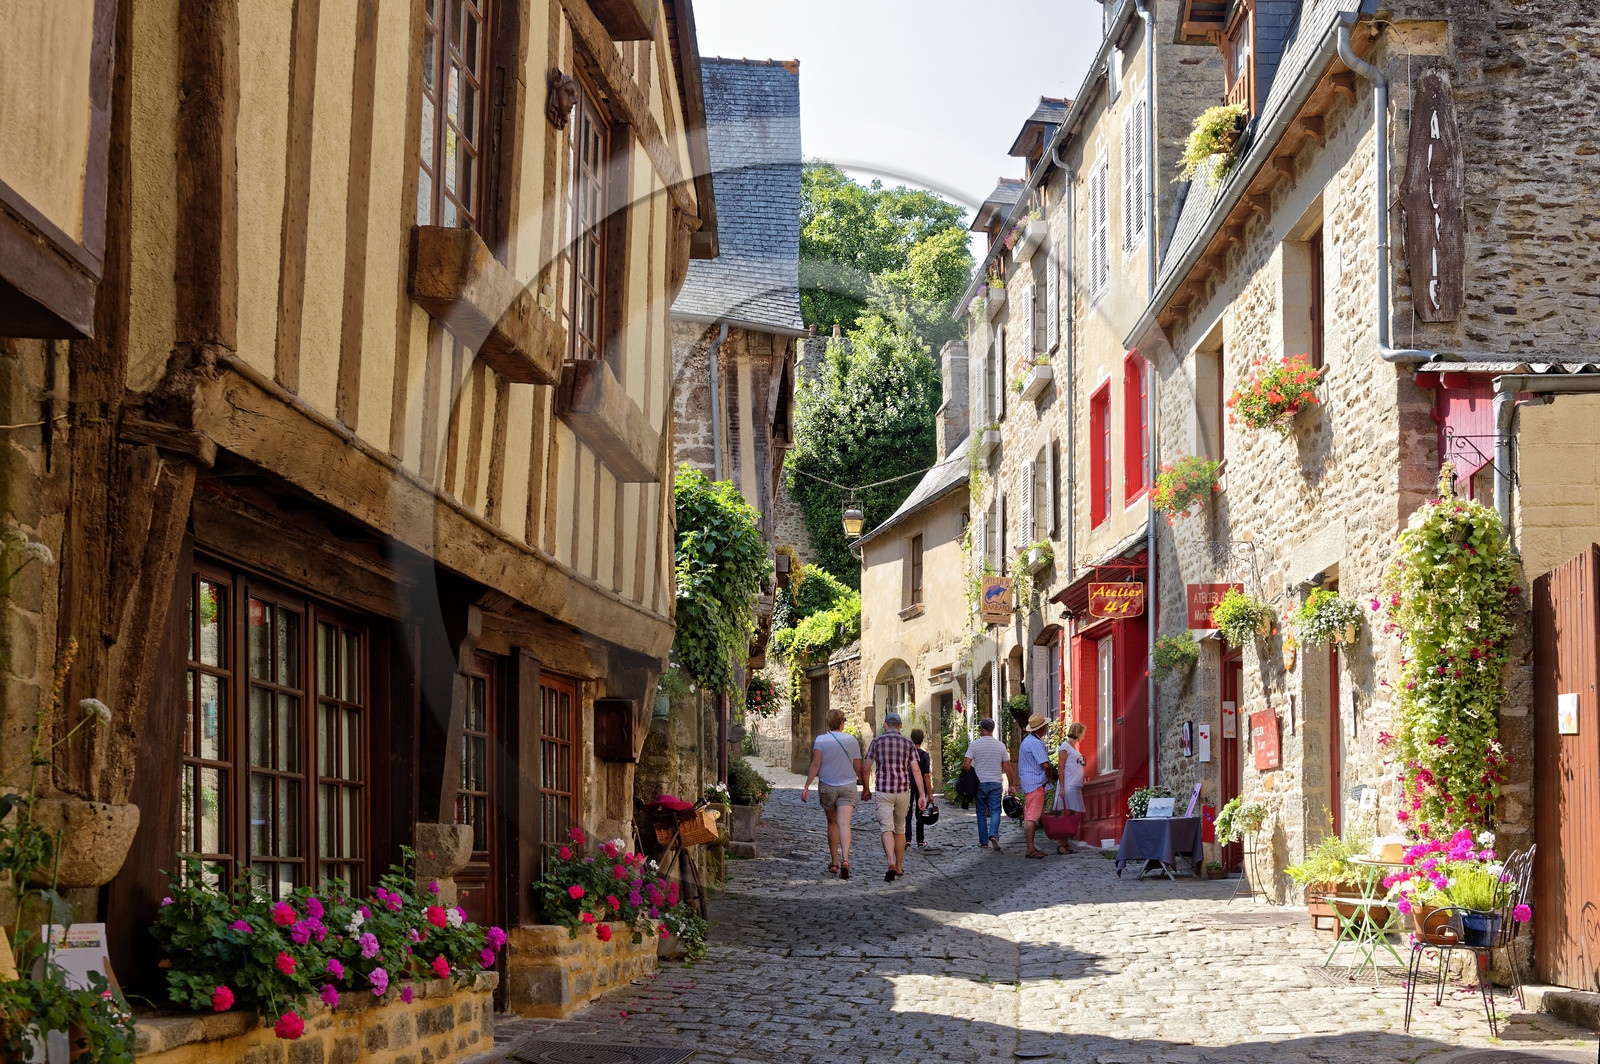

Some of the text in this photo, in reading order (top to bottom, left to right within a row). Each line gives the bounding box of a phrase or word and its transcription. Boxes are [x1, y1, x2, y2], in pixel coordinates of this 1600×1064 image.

[1090, 586, 1142, 600] Atelier
[1193, 591, 1219, 604] ATELIER
[983, 603, 1010, 611] BARBARO
[1103, 601, 1130, 614] 41
